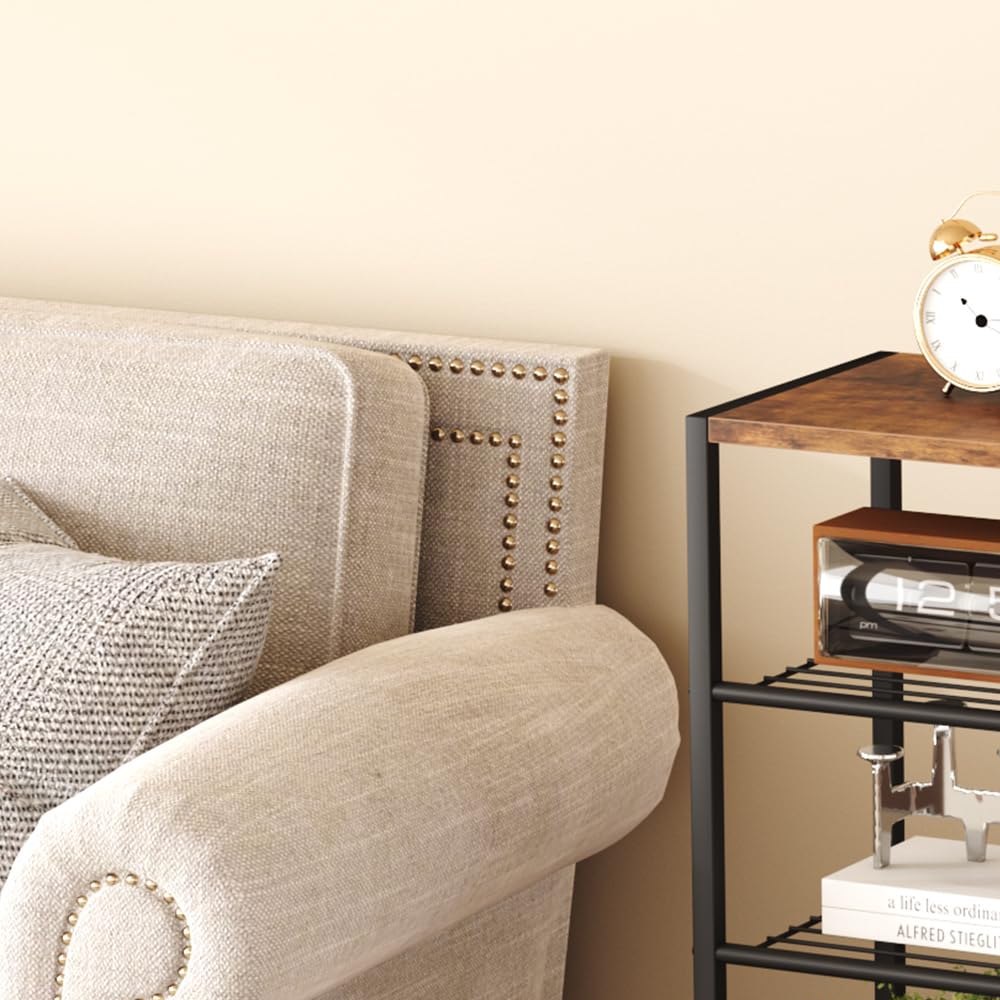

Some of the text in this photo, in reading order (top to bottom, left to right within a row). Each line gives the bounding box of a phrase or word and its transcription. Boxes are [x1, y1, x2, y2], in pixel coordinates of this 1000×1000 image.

[859, 621, 879, 631] pm
[887, 897, 896, 910] a
[900, 895, 921, 912] life
[925, 897, 949, 915] less
[896, 923, 945, 943] ALFRED
